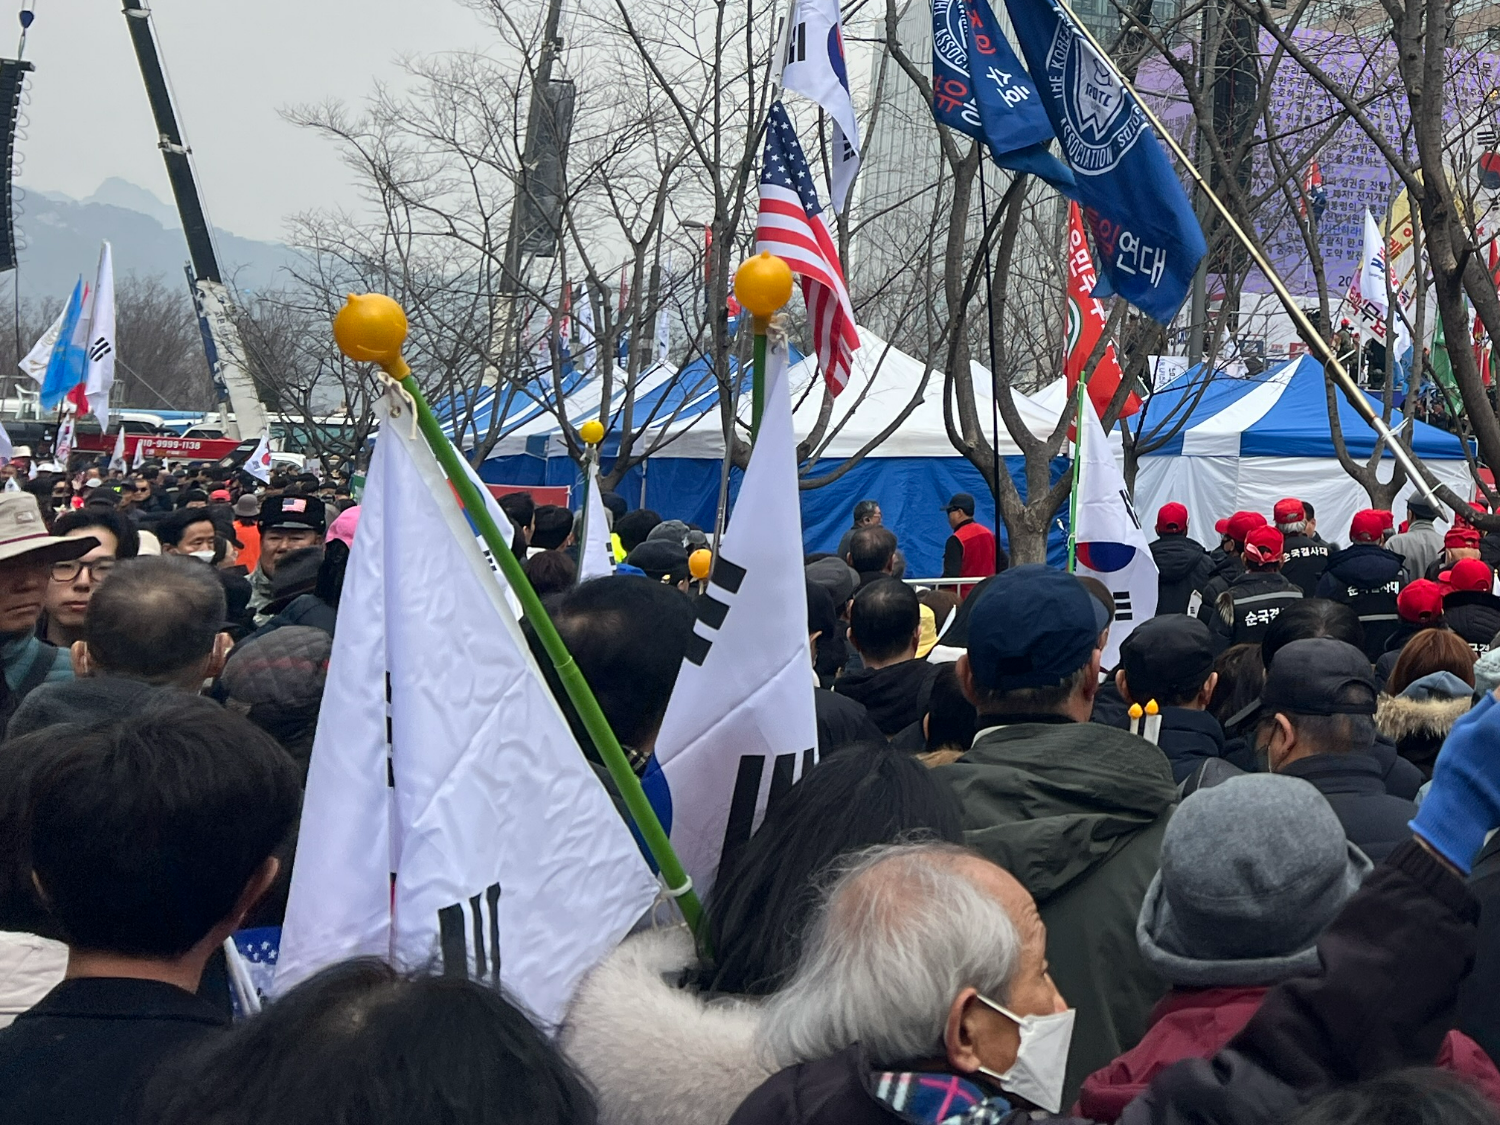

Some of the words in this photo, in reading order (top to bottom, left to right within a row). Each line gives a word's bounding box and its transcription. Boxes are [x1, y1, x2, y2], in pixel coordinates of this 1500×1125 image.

[1049, 74, 1063, 100] THE
[1085, 82, 1113, 108] ROTC
[1059, 116, 1113, 169] ASSOCIATION
[1283, 546, 1328, 563] 순국결사대
[1347, 580, 1400, 597] 순사대
[1244, 607, 1284, 627] 순국결
